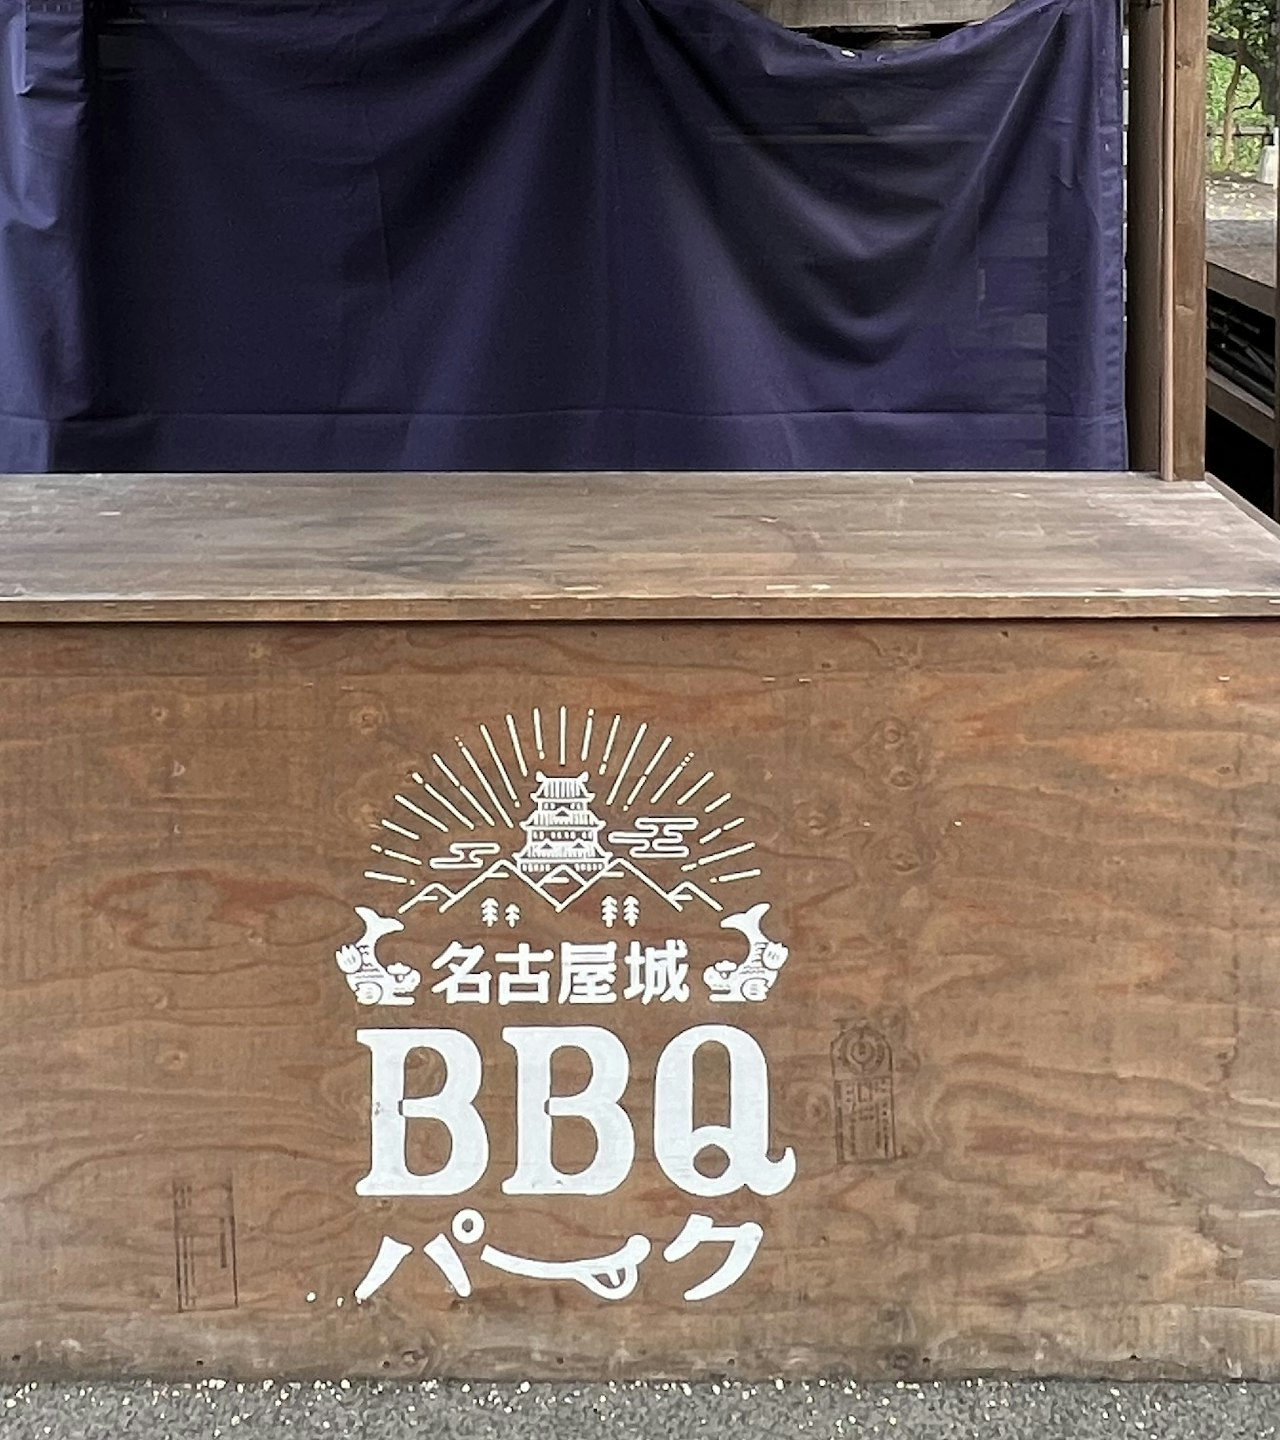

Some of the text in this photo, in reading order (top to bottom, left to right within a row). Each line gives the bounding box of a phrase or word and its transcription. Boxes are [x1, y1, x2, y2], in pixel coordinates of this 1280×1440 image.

[431, 939, 690, 1006] 名古屋城
[355, 1024, 797, 1197] BBQ
[354, 1208, 765, 1303] パーク
